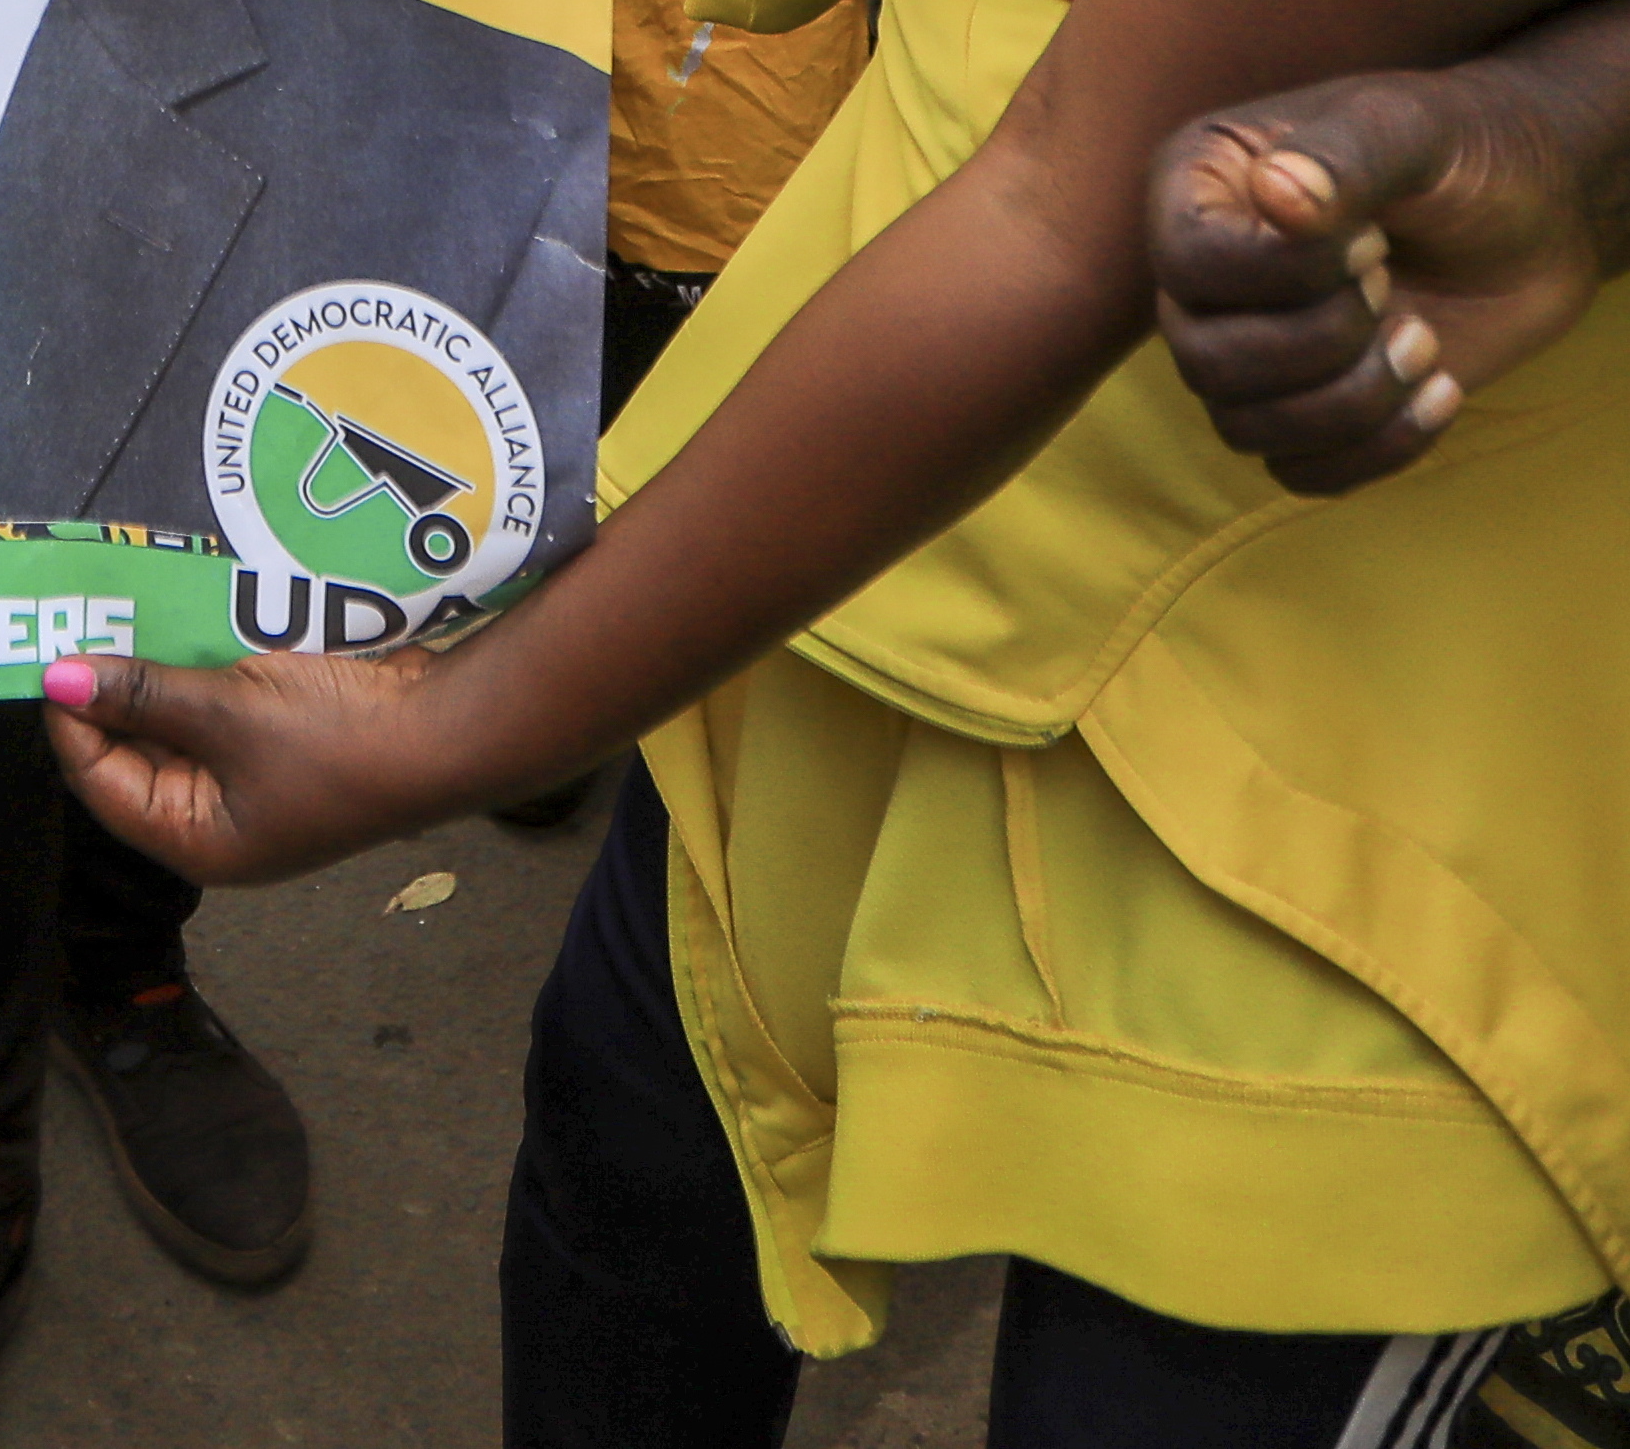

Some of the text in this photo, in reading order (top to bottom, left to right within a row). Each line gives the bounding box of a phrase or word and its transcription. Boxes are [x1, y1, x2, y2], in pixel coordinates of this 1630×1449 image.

[214, 297, 539, 539] UNITED DEMOCRATIC ALLIANCE
[234, 569, 487, 654] UDA
